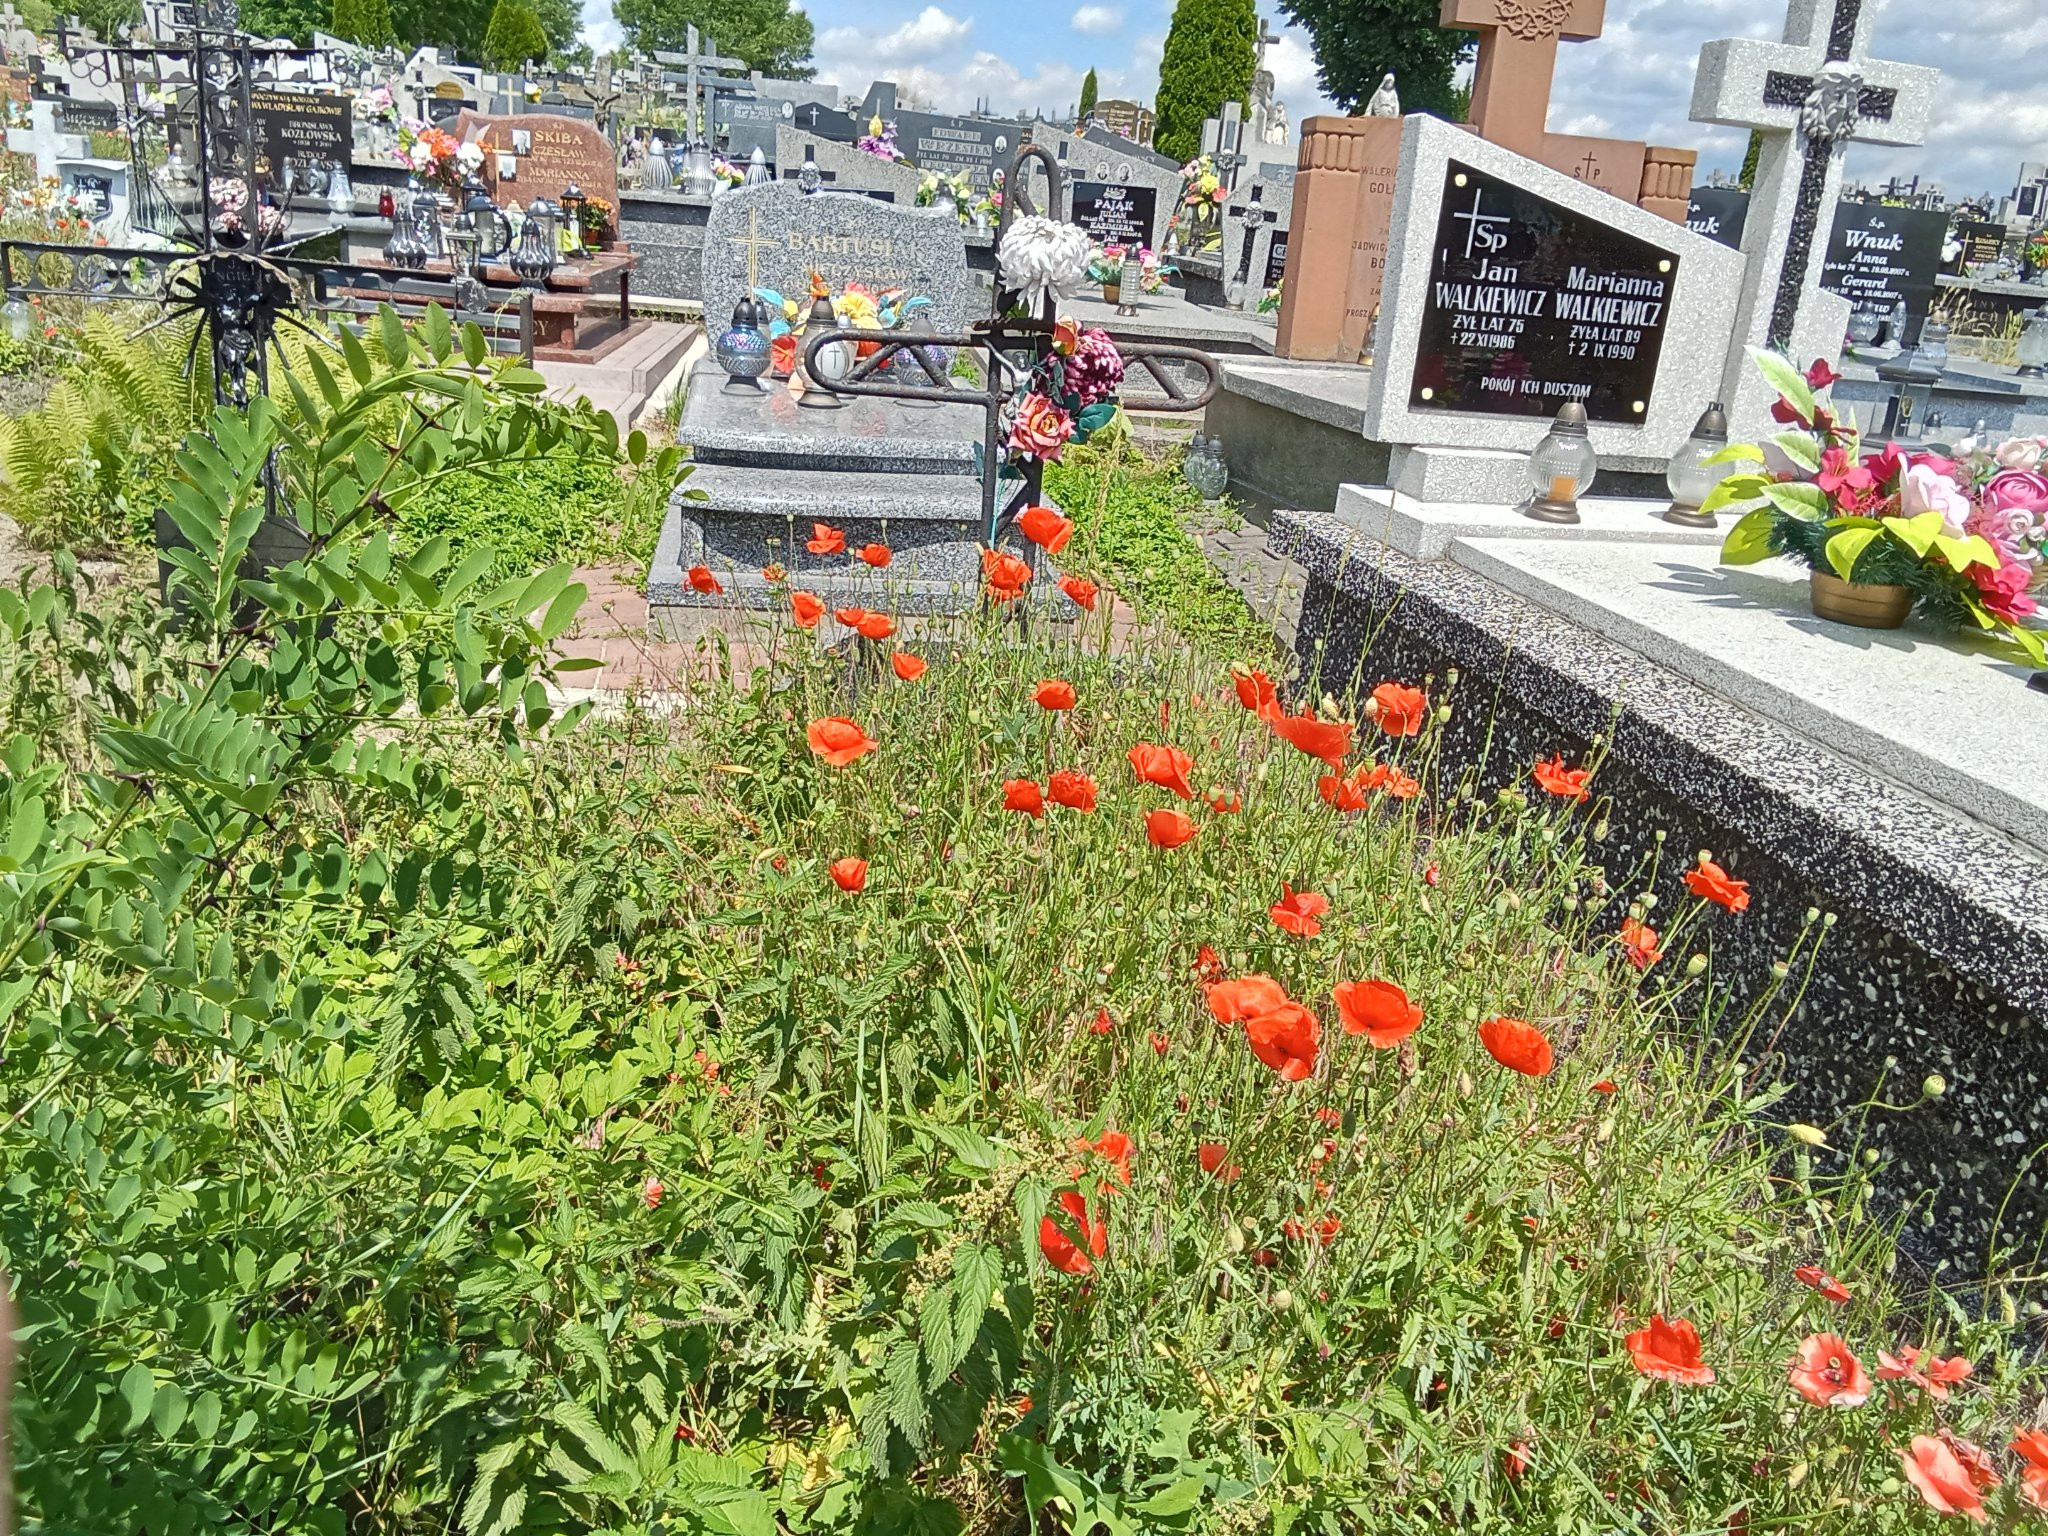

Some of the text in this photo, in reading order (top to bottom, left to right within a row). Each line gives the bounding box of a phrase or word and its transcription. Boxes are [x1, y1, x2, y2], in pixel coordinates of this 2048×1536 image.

[534, 130, 583, 145] SKIBA
[933, 129, 980, 141] EDWARD
[532, 145, 586, 159] CZESŁAW
[529, 166, 591, 181] MARIANNA
[1094, 199, 1134, 212] PAJĄK
[1100, 210, 1128, 219] JULIAN
[1090, 221, 1135, 232] KAZIMIERA
[1103, 234, 1119, 242] JAN
[1846, 229, 1903, 251] Wnuk
[1352, 241, 1388, 252] JADWIG
[1850, 251, 1889, 265] Anna
[1472, 258, 1518, 283] Jan
[1567, 266, 1664, 297] Marianna
[1842, 274, 1888, 289] Gerard
[1436, 282, 1547, 317] WALKIEWICZ
[1555, 292, 1662, 327] WALKIEWICZ
[1481, 316, 1505, 331] LAT
[1508, 318, 1525, 333] 75
[1602, 327, 1623, 342] LAT
[1579, 342, 1636, 360] 2 IX 1990
[1480, 376, 1592, 398] POKÓJ ICH DUSZOM
